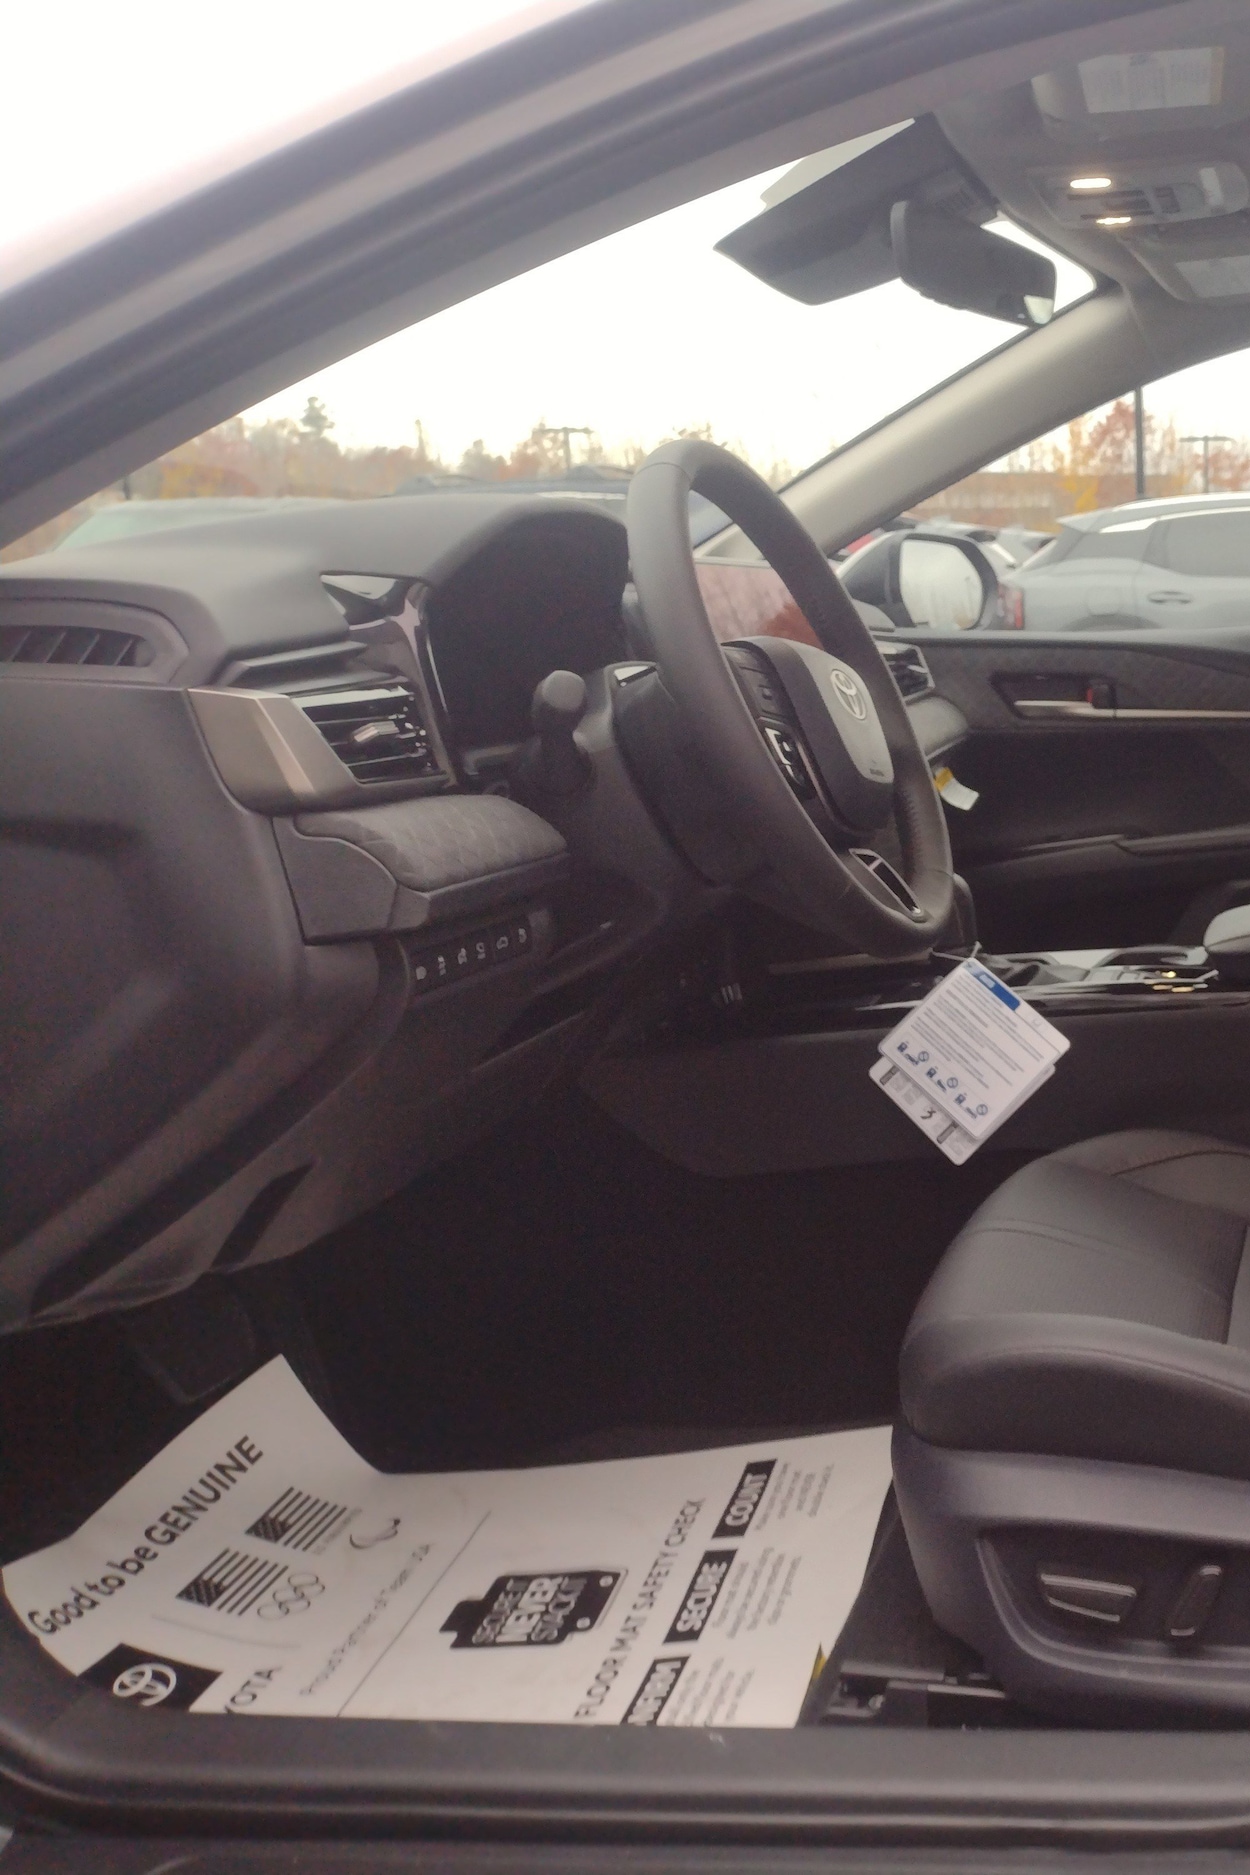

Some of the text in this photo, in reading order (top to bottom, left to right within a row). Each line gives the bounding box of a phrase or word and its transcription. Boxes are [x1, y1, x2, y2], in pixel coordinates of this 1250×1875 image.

[28, 1434, 264, 1634] Good to be GENUINE
[725, 1473, 768, 1526] COUNT
[496, 1577, 564, 1643] NEVER
[574, 1498, 706, 1717] FLOOR MAT SAFETY CHECK
[676, 1561, 728, 1633] SECURE
